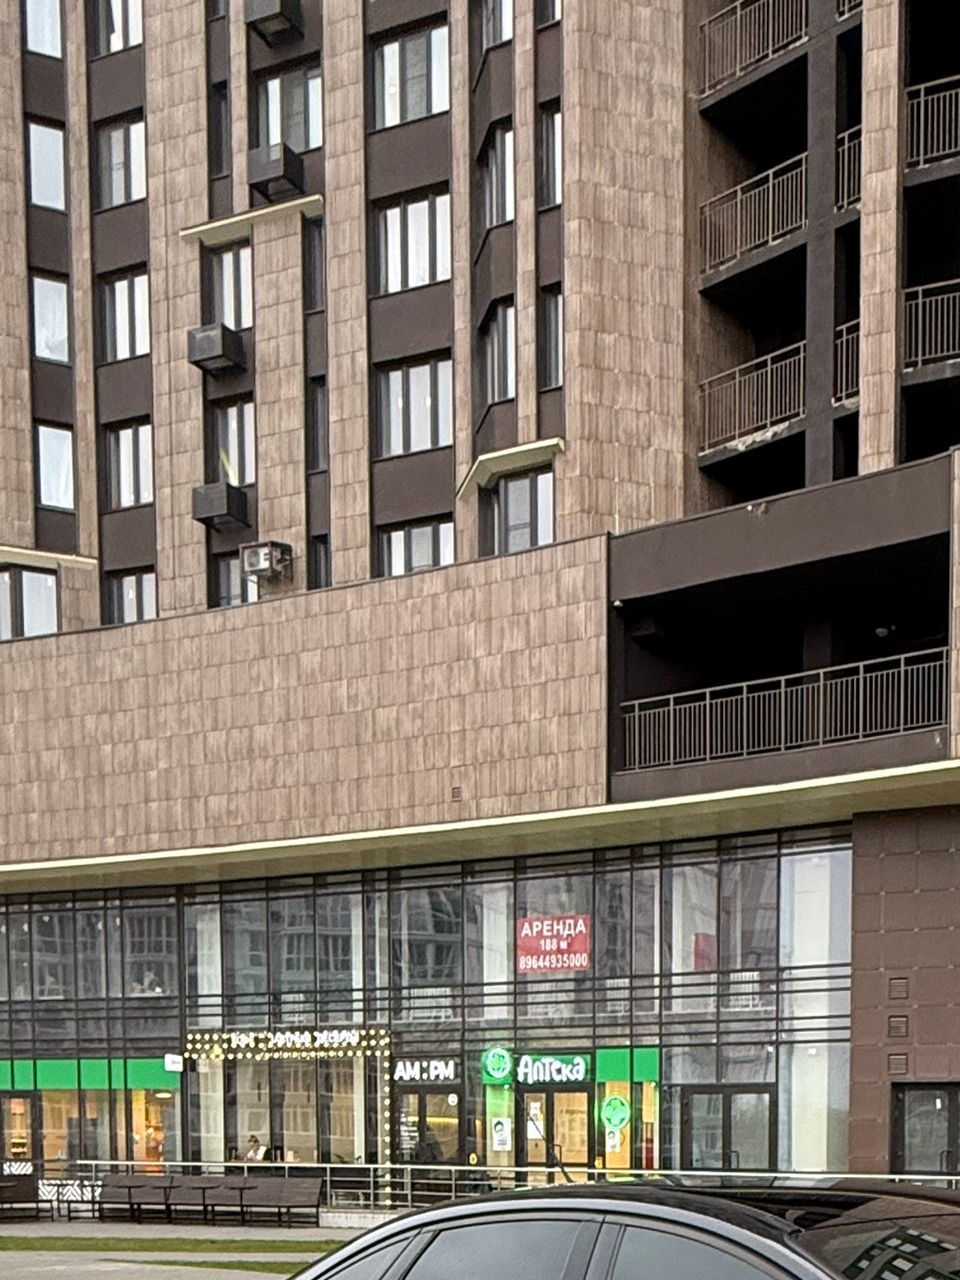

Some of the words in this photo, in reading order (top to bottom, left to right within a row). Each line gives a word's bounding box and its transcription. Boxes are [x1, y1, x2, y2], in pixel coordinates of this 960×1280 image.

[521, 919, 586, 937] АРЕНДА
[539, 938, 558, 951] 188
[520, 953, 588, 969] 89644935000
[393, 1060, 455, 1082] AM:PM
[517, 1055, 585, 1084] Аптека
